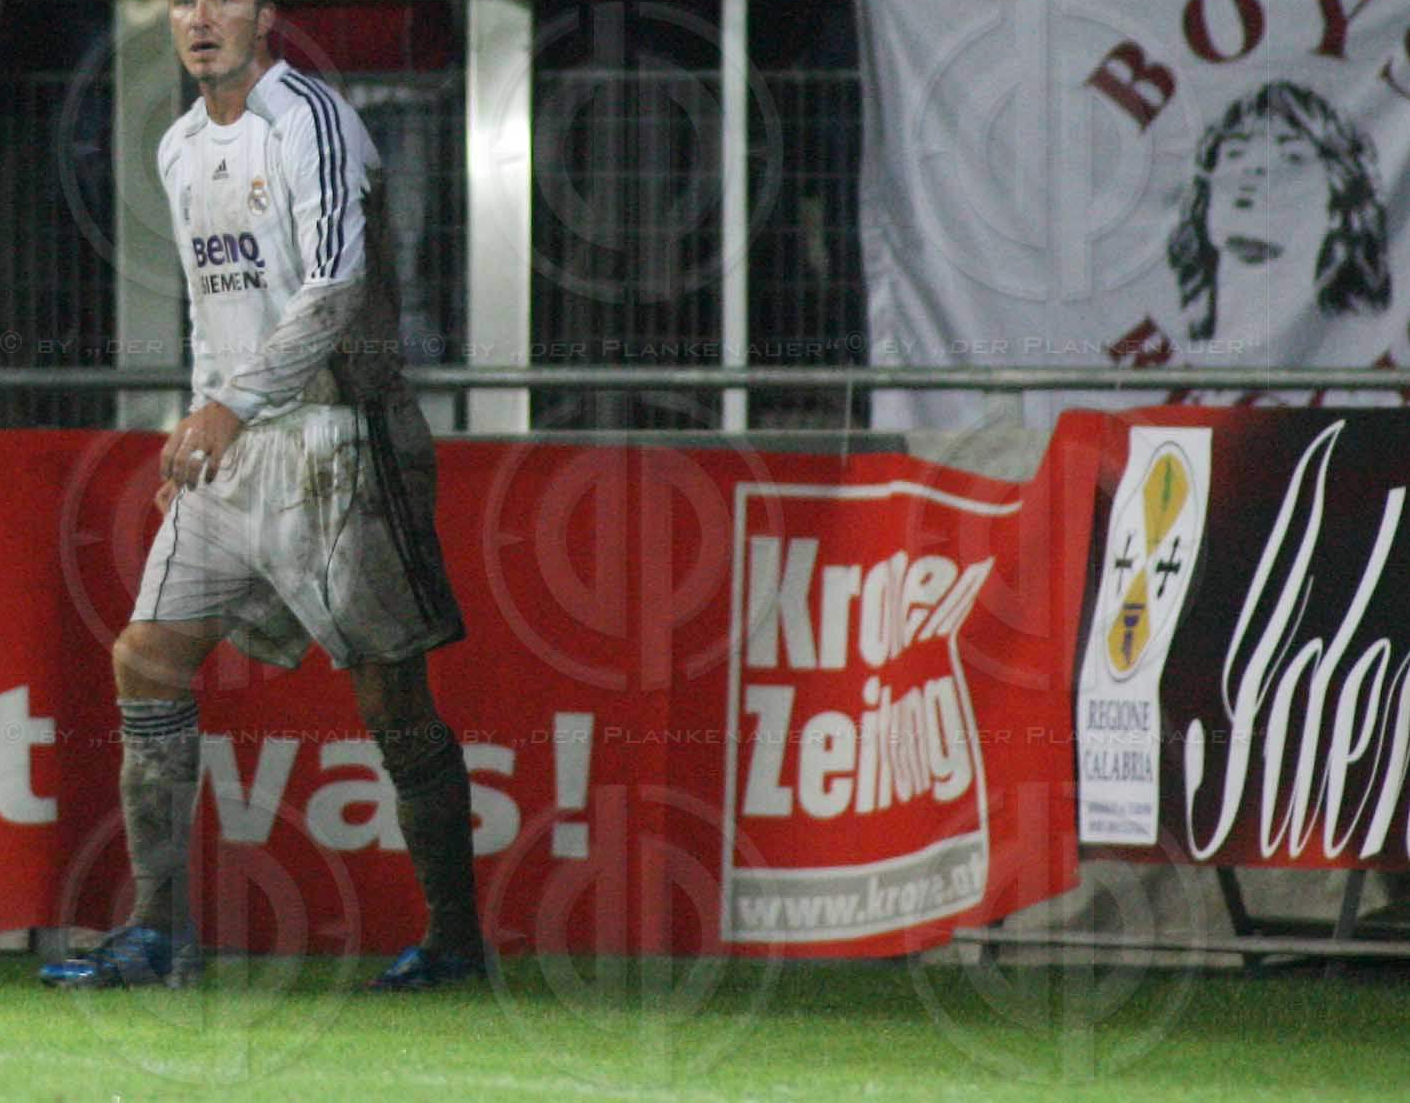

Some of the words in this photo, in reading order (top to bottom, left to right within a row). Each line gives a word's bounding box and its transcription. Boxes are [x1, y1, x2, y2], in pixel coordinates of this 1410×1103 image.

[192, 232, 266, 268] BenQ
[746, 535, 996, 669] Kroen
[1087, 699, 1151, 732] REGIONE
[1084, 751, 1154, 782] CALABRIA
